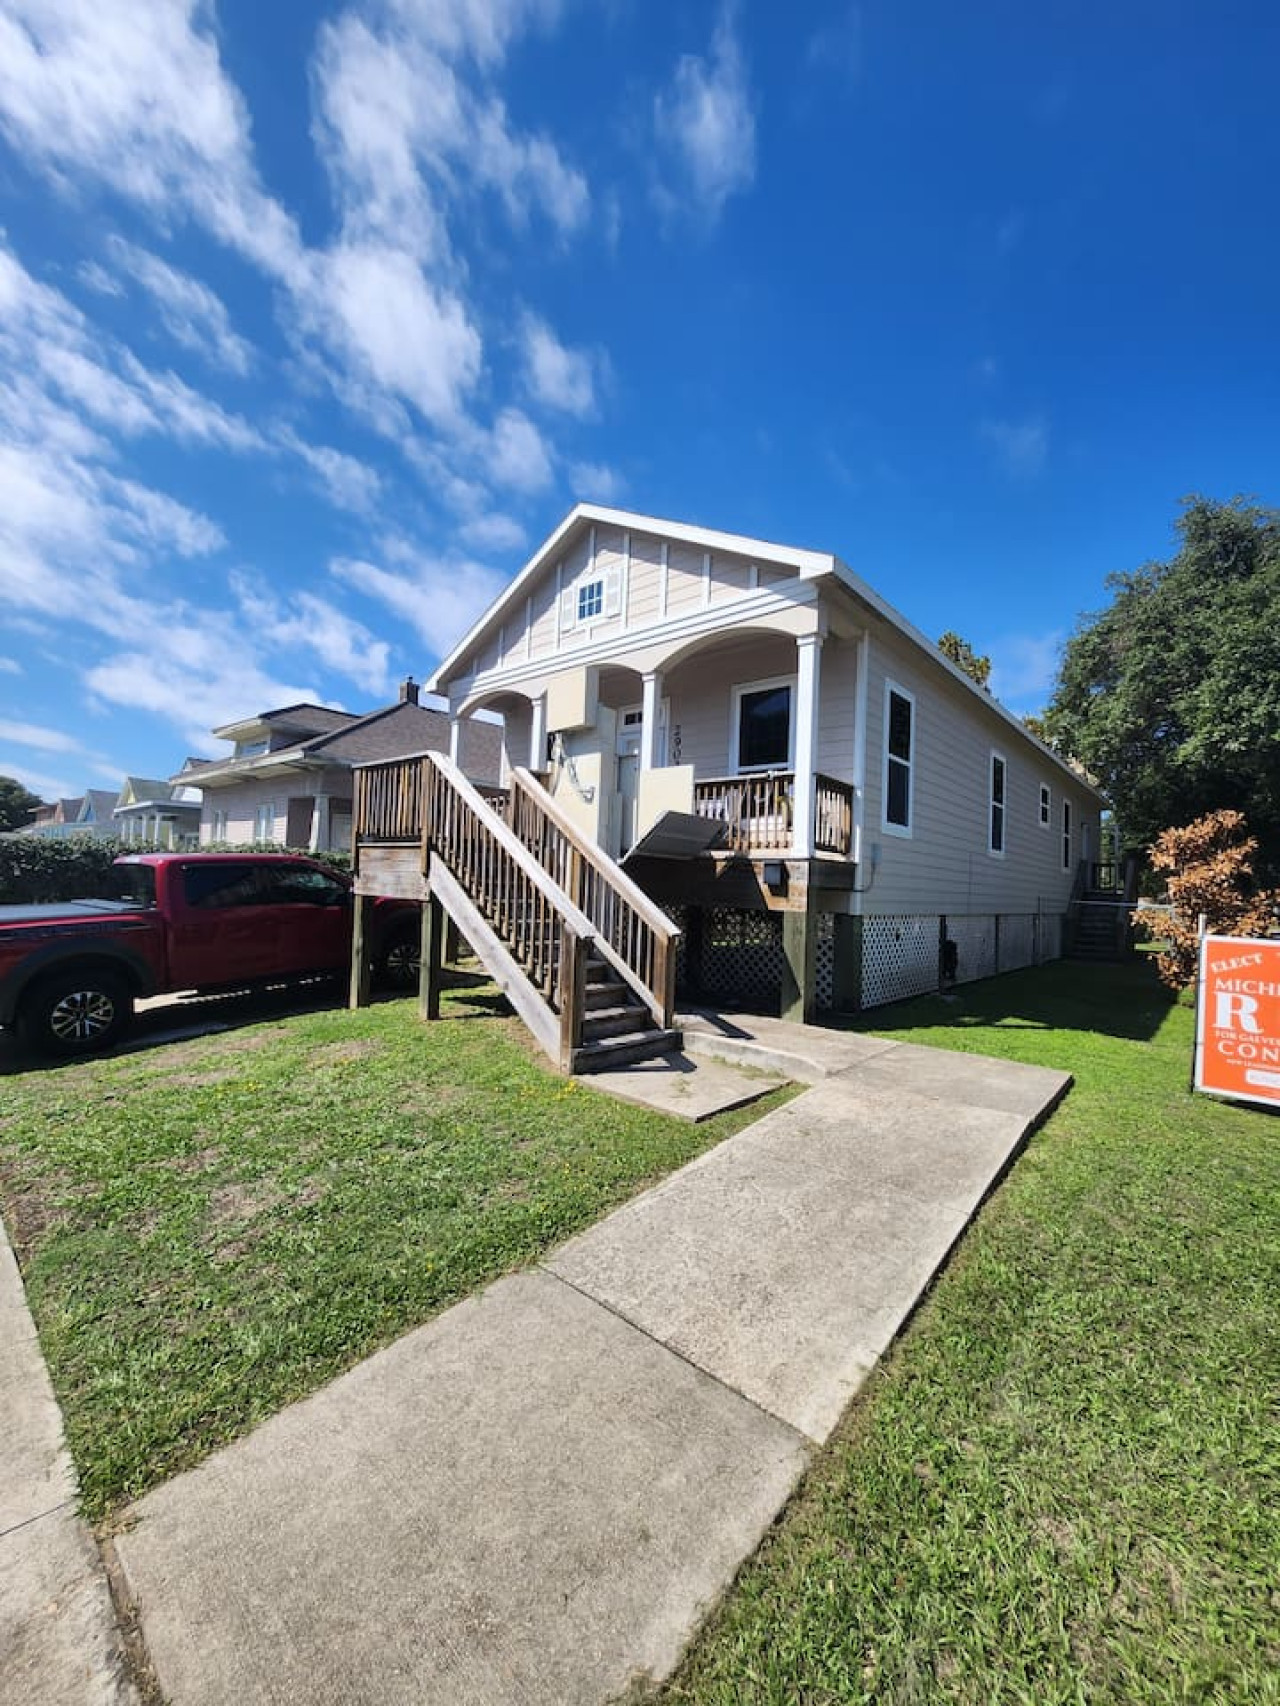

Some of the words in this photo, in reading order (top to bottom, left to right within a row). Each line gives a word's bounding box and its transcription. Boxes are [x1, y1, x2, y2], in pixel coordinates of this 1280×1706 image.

[1211, 952, 1263, 973] ELECT
[1215, 978, 1280, 996] MICH
[1212, 991, 1264, 1034] R
[1215, 1030, 1237, 1040] FOR
